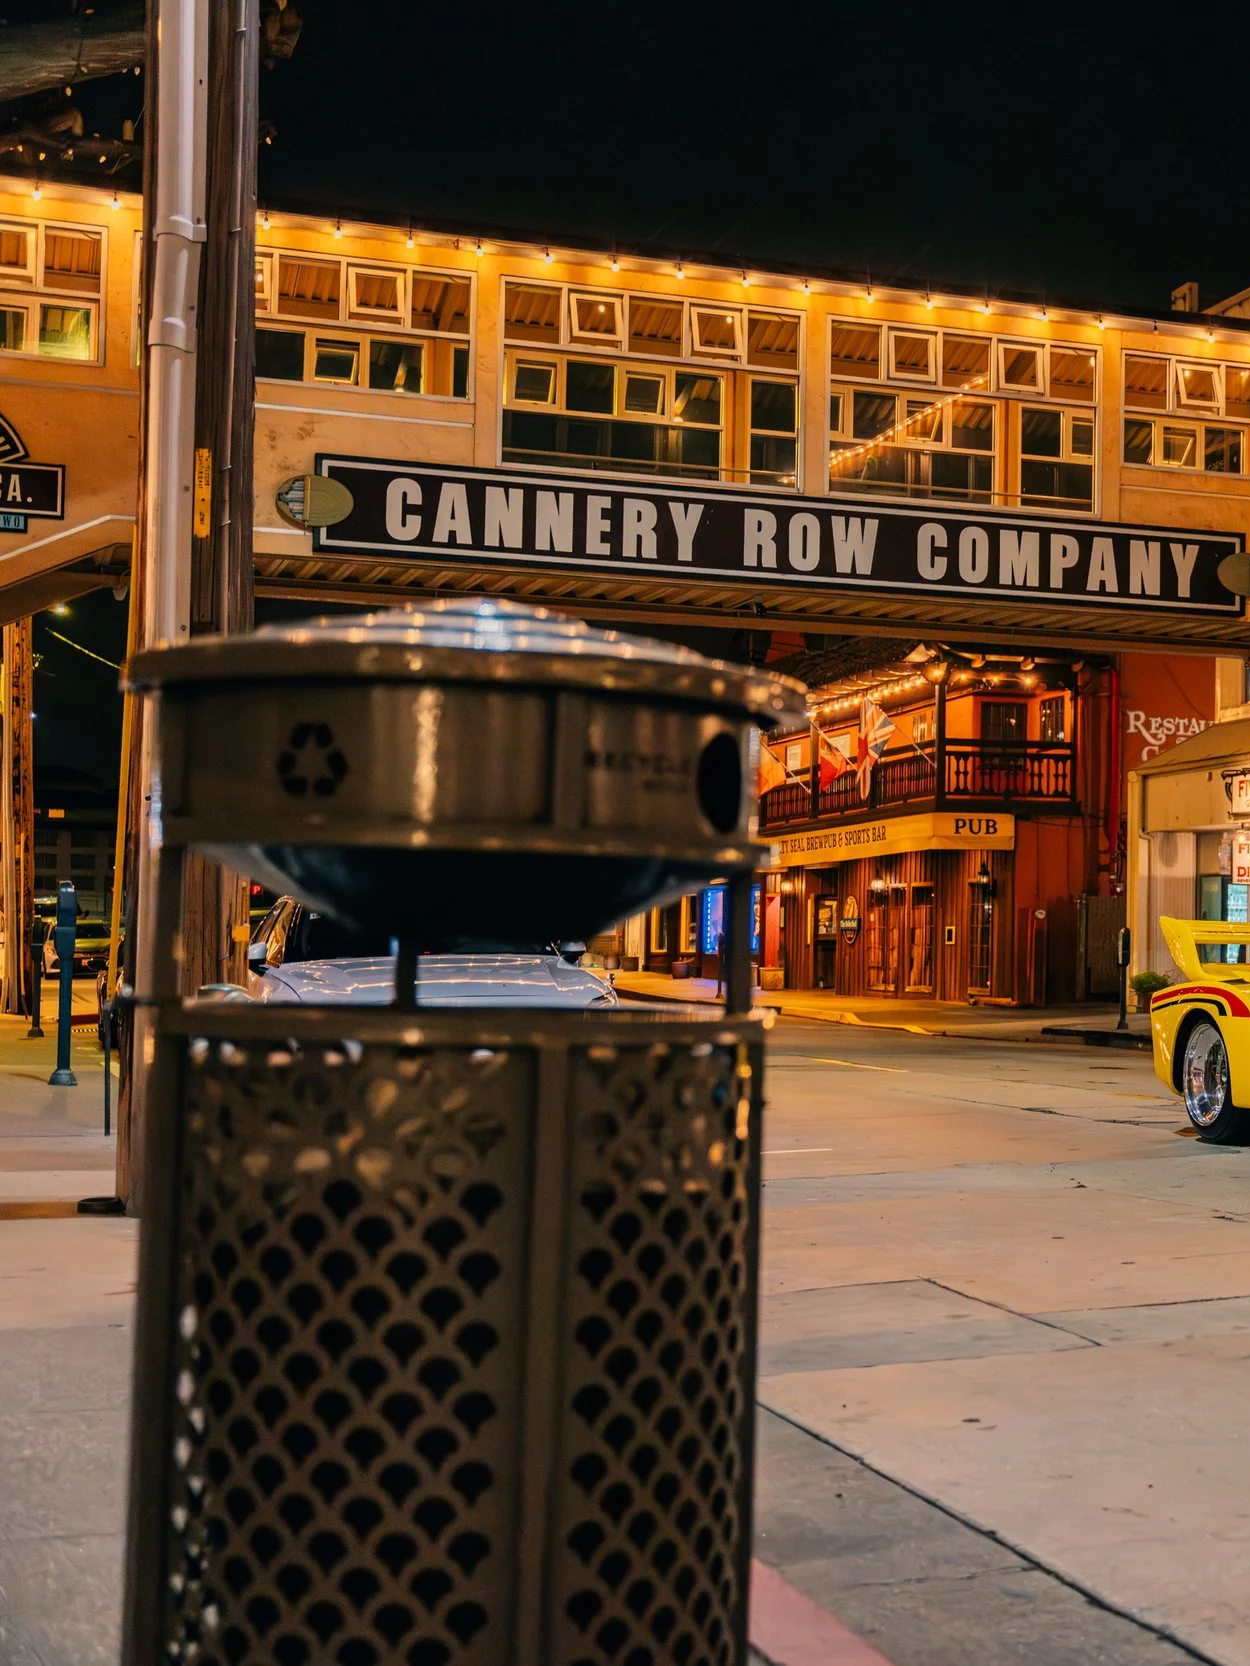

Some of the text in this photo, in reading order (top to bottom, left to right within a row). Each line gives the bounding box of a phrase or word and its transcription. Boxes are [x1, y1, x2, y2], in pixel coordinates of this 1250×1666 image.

[0, 473, 33, 503] A.
[384, 477, 1200, 598] CANNERY ROW COMPANY
[790, 838, 805, 853] SEAL
[806, 832, 837, 851] BREWPUB
[838, 832, 843, 848] &
[845, 828, 870, 846] SPORTS
[872, 825, 887, 842] BAR
[953, 817, 998, 835] PUB
